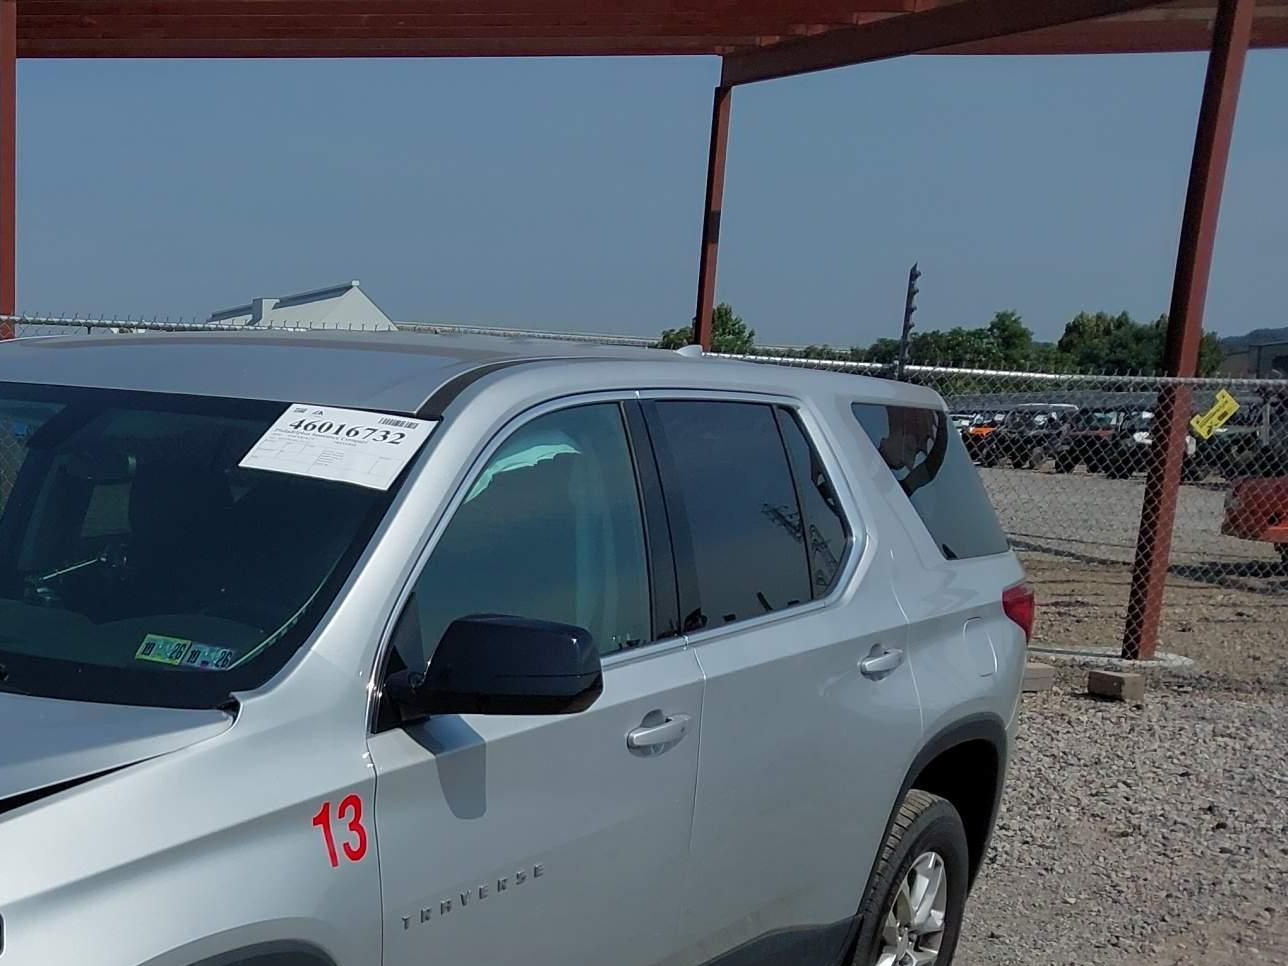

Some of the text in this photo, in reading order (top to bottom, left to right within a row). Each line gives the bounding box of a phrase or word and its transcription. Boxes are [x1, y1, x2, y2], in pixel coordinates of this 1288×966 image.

[288, 418, 407, 445] 46016732
[312, 793, 367, 868] 13
[402, 863, 544, 930] TRAVERSE
